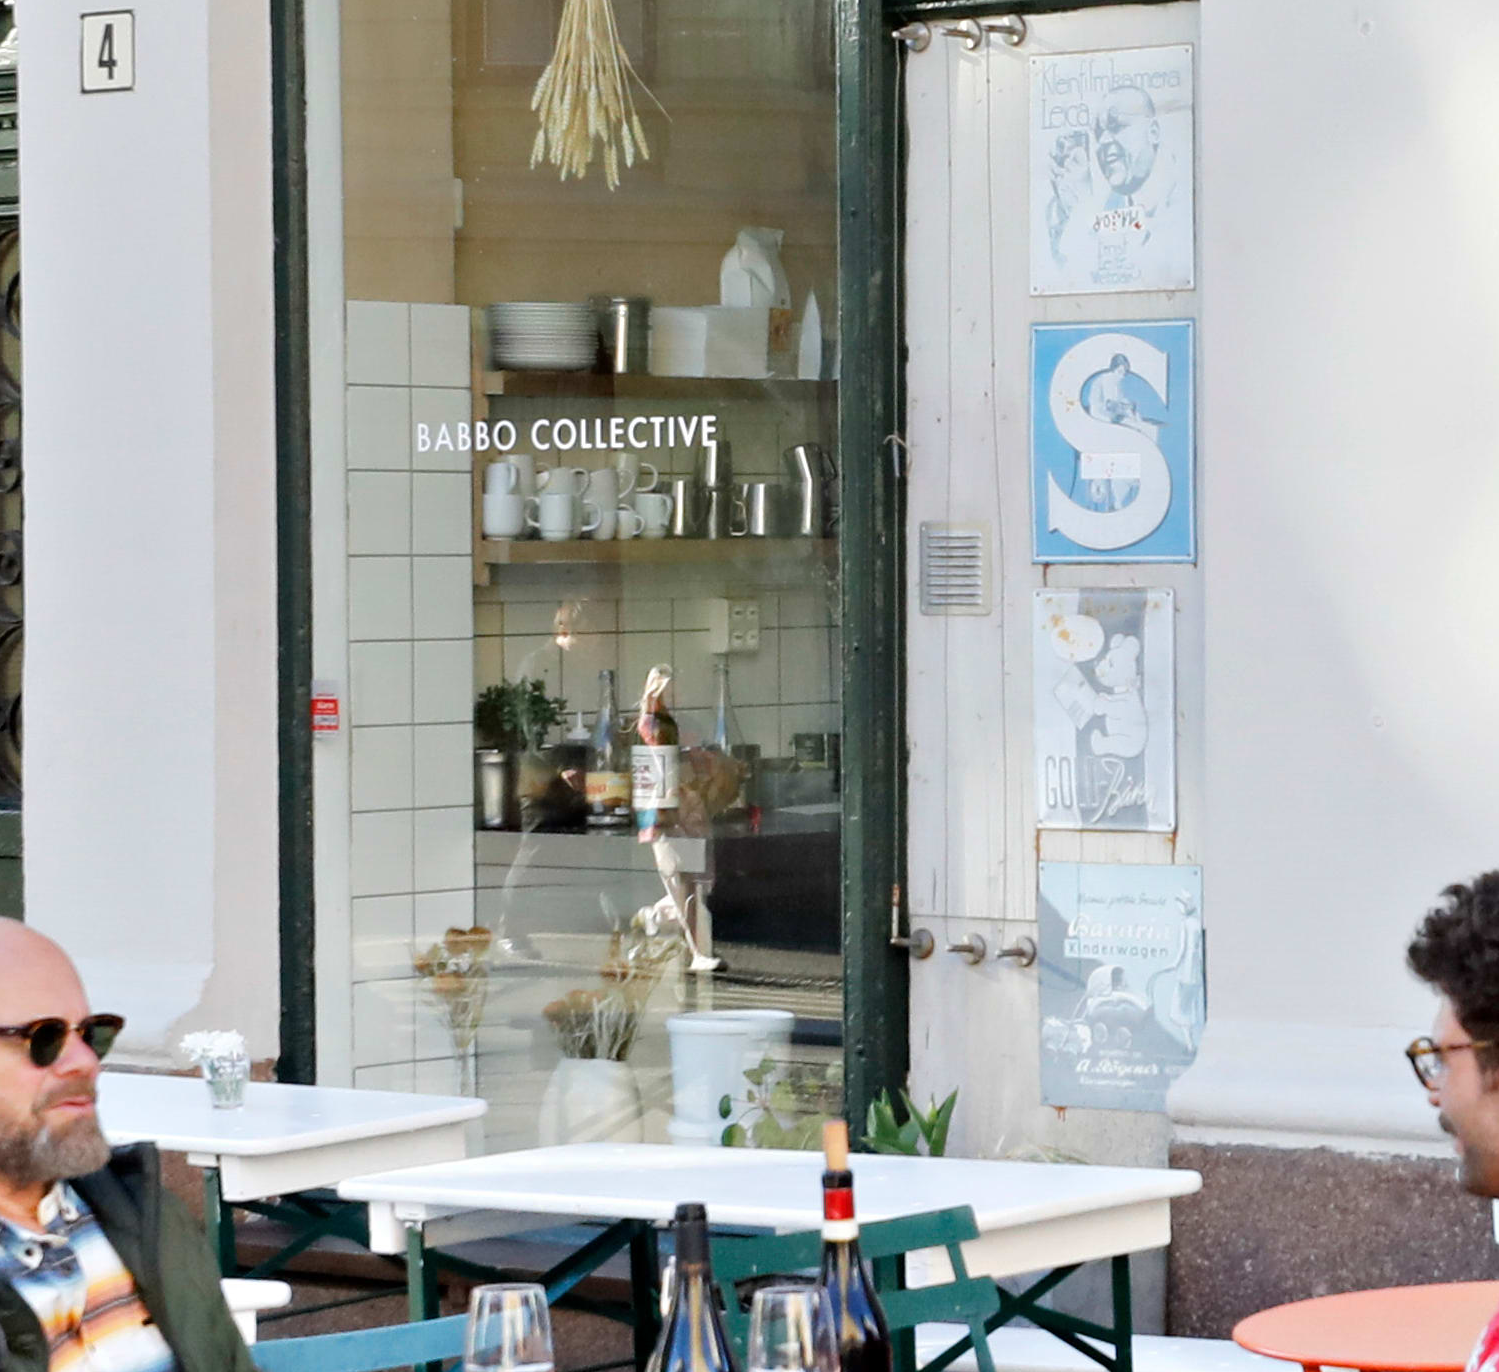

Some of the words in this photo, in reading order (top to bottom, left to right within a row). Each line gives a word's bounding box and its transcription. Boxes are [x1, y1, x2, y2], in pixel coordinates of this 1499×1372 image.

[97, 23, 118, 81] 4
[417, 420, 517, 453] BABBO
[530, 415, 716, 451] COLLECTIVE
